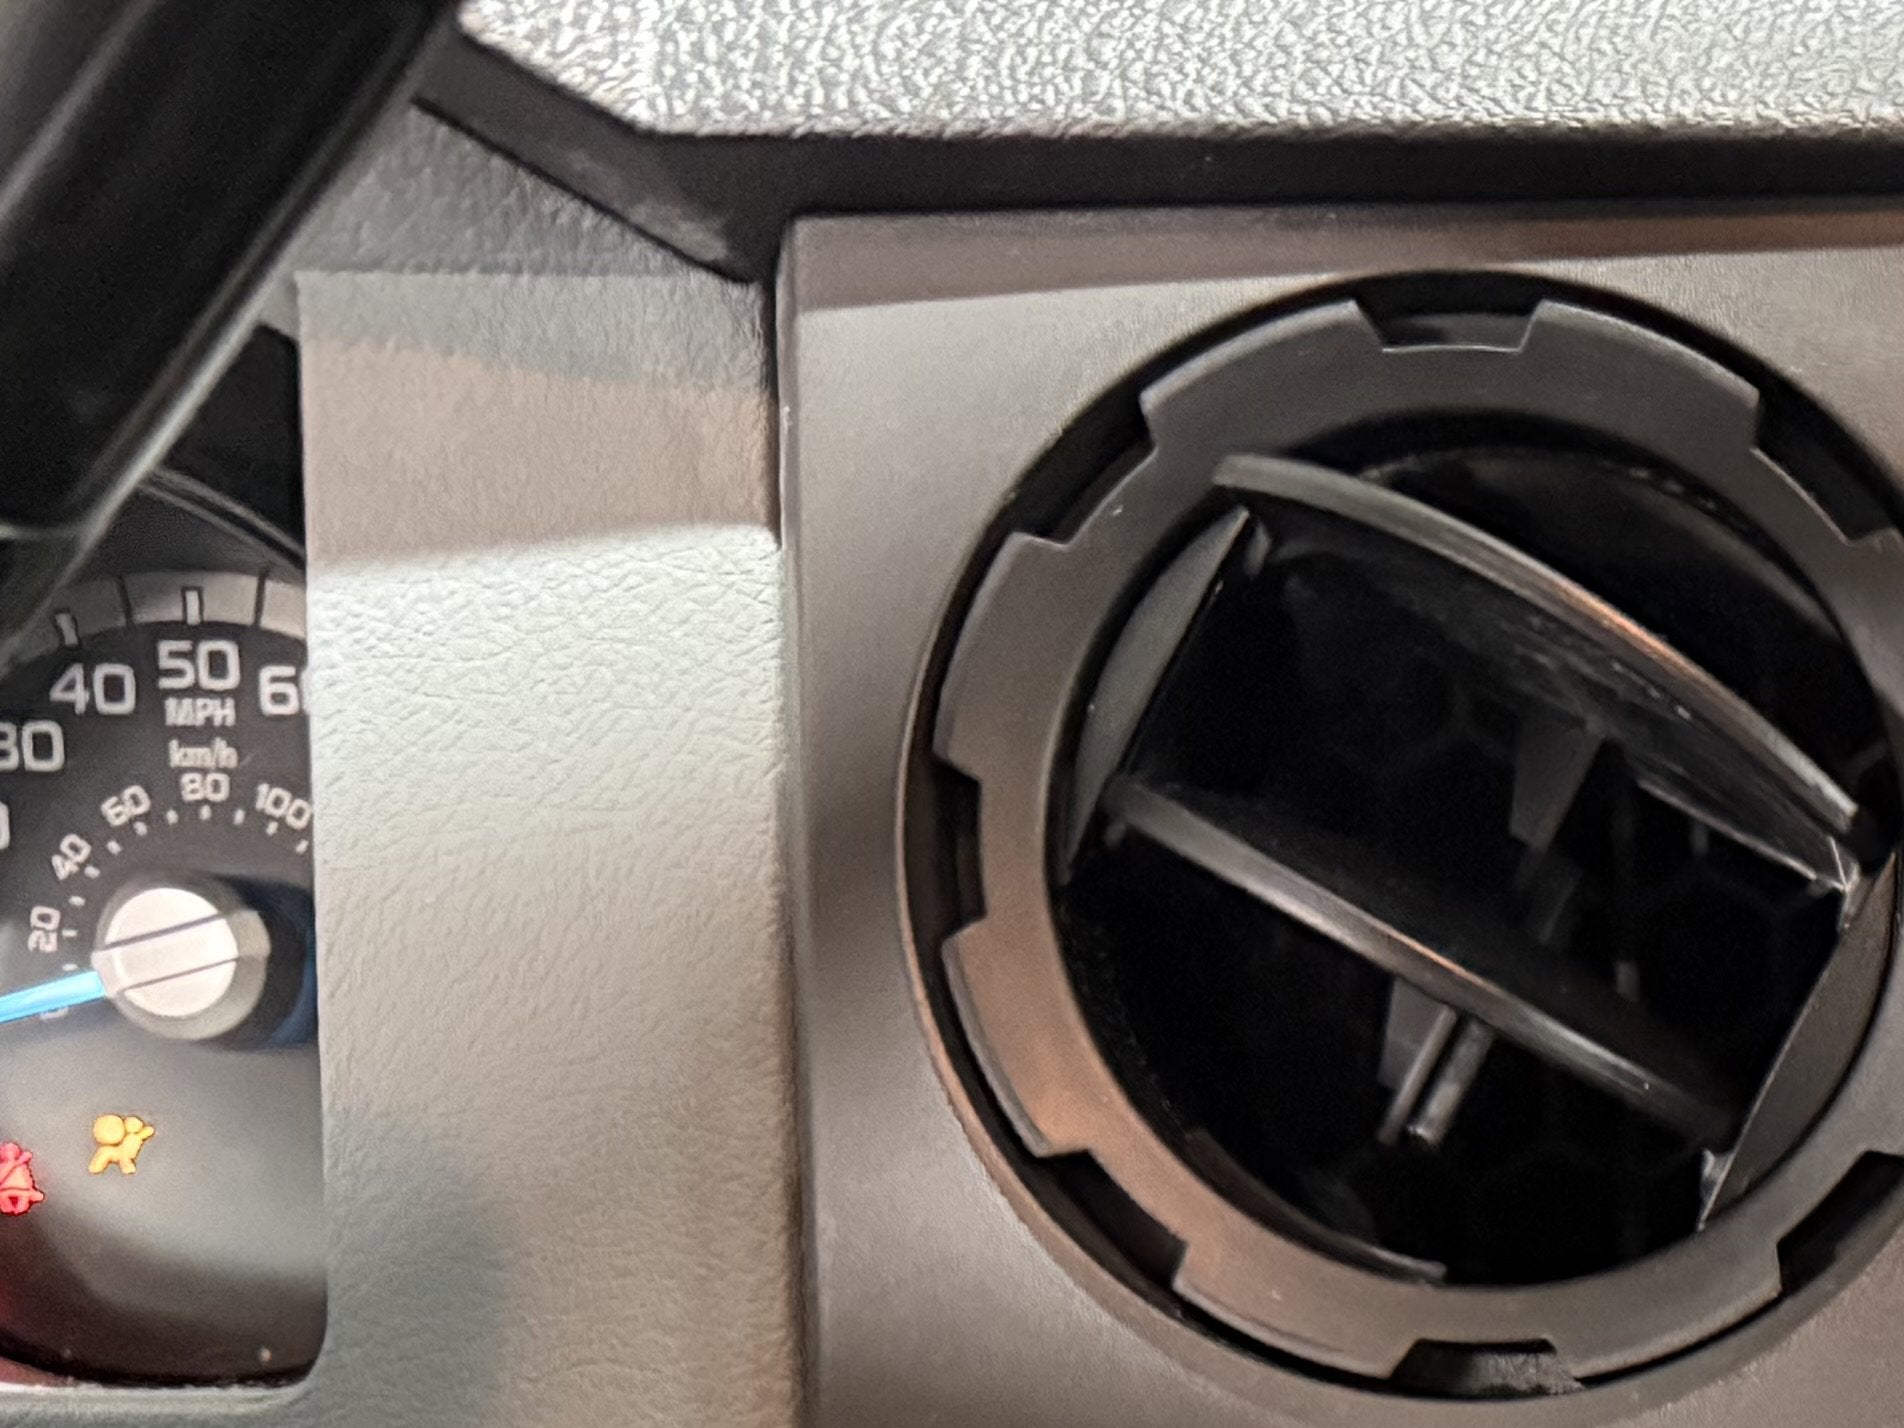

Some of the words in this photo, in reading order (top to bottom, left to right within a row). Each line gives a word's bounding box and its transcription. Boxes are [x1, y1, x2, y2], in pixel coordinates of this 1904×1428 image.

[49, 661, 137, 716] 40
[156, 638, 241, 691] 50
[164, 696, 236, 728] MPH
[258, 664, 307, 717] 6
[167, 736, 239, 769] km/h
[100, 784, 152, 828] 60
[179, 771, 231, 803] 80
[254, 782, 313, 831] 100
[51, 833, 93, 881] 40
[27, 904, 61, 953] 20
